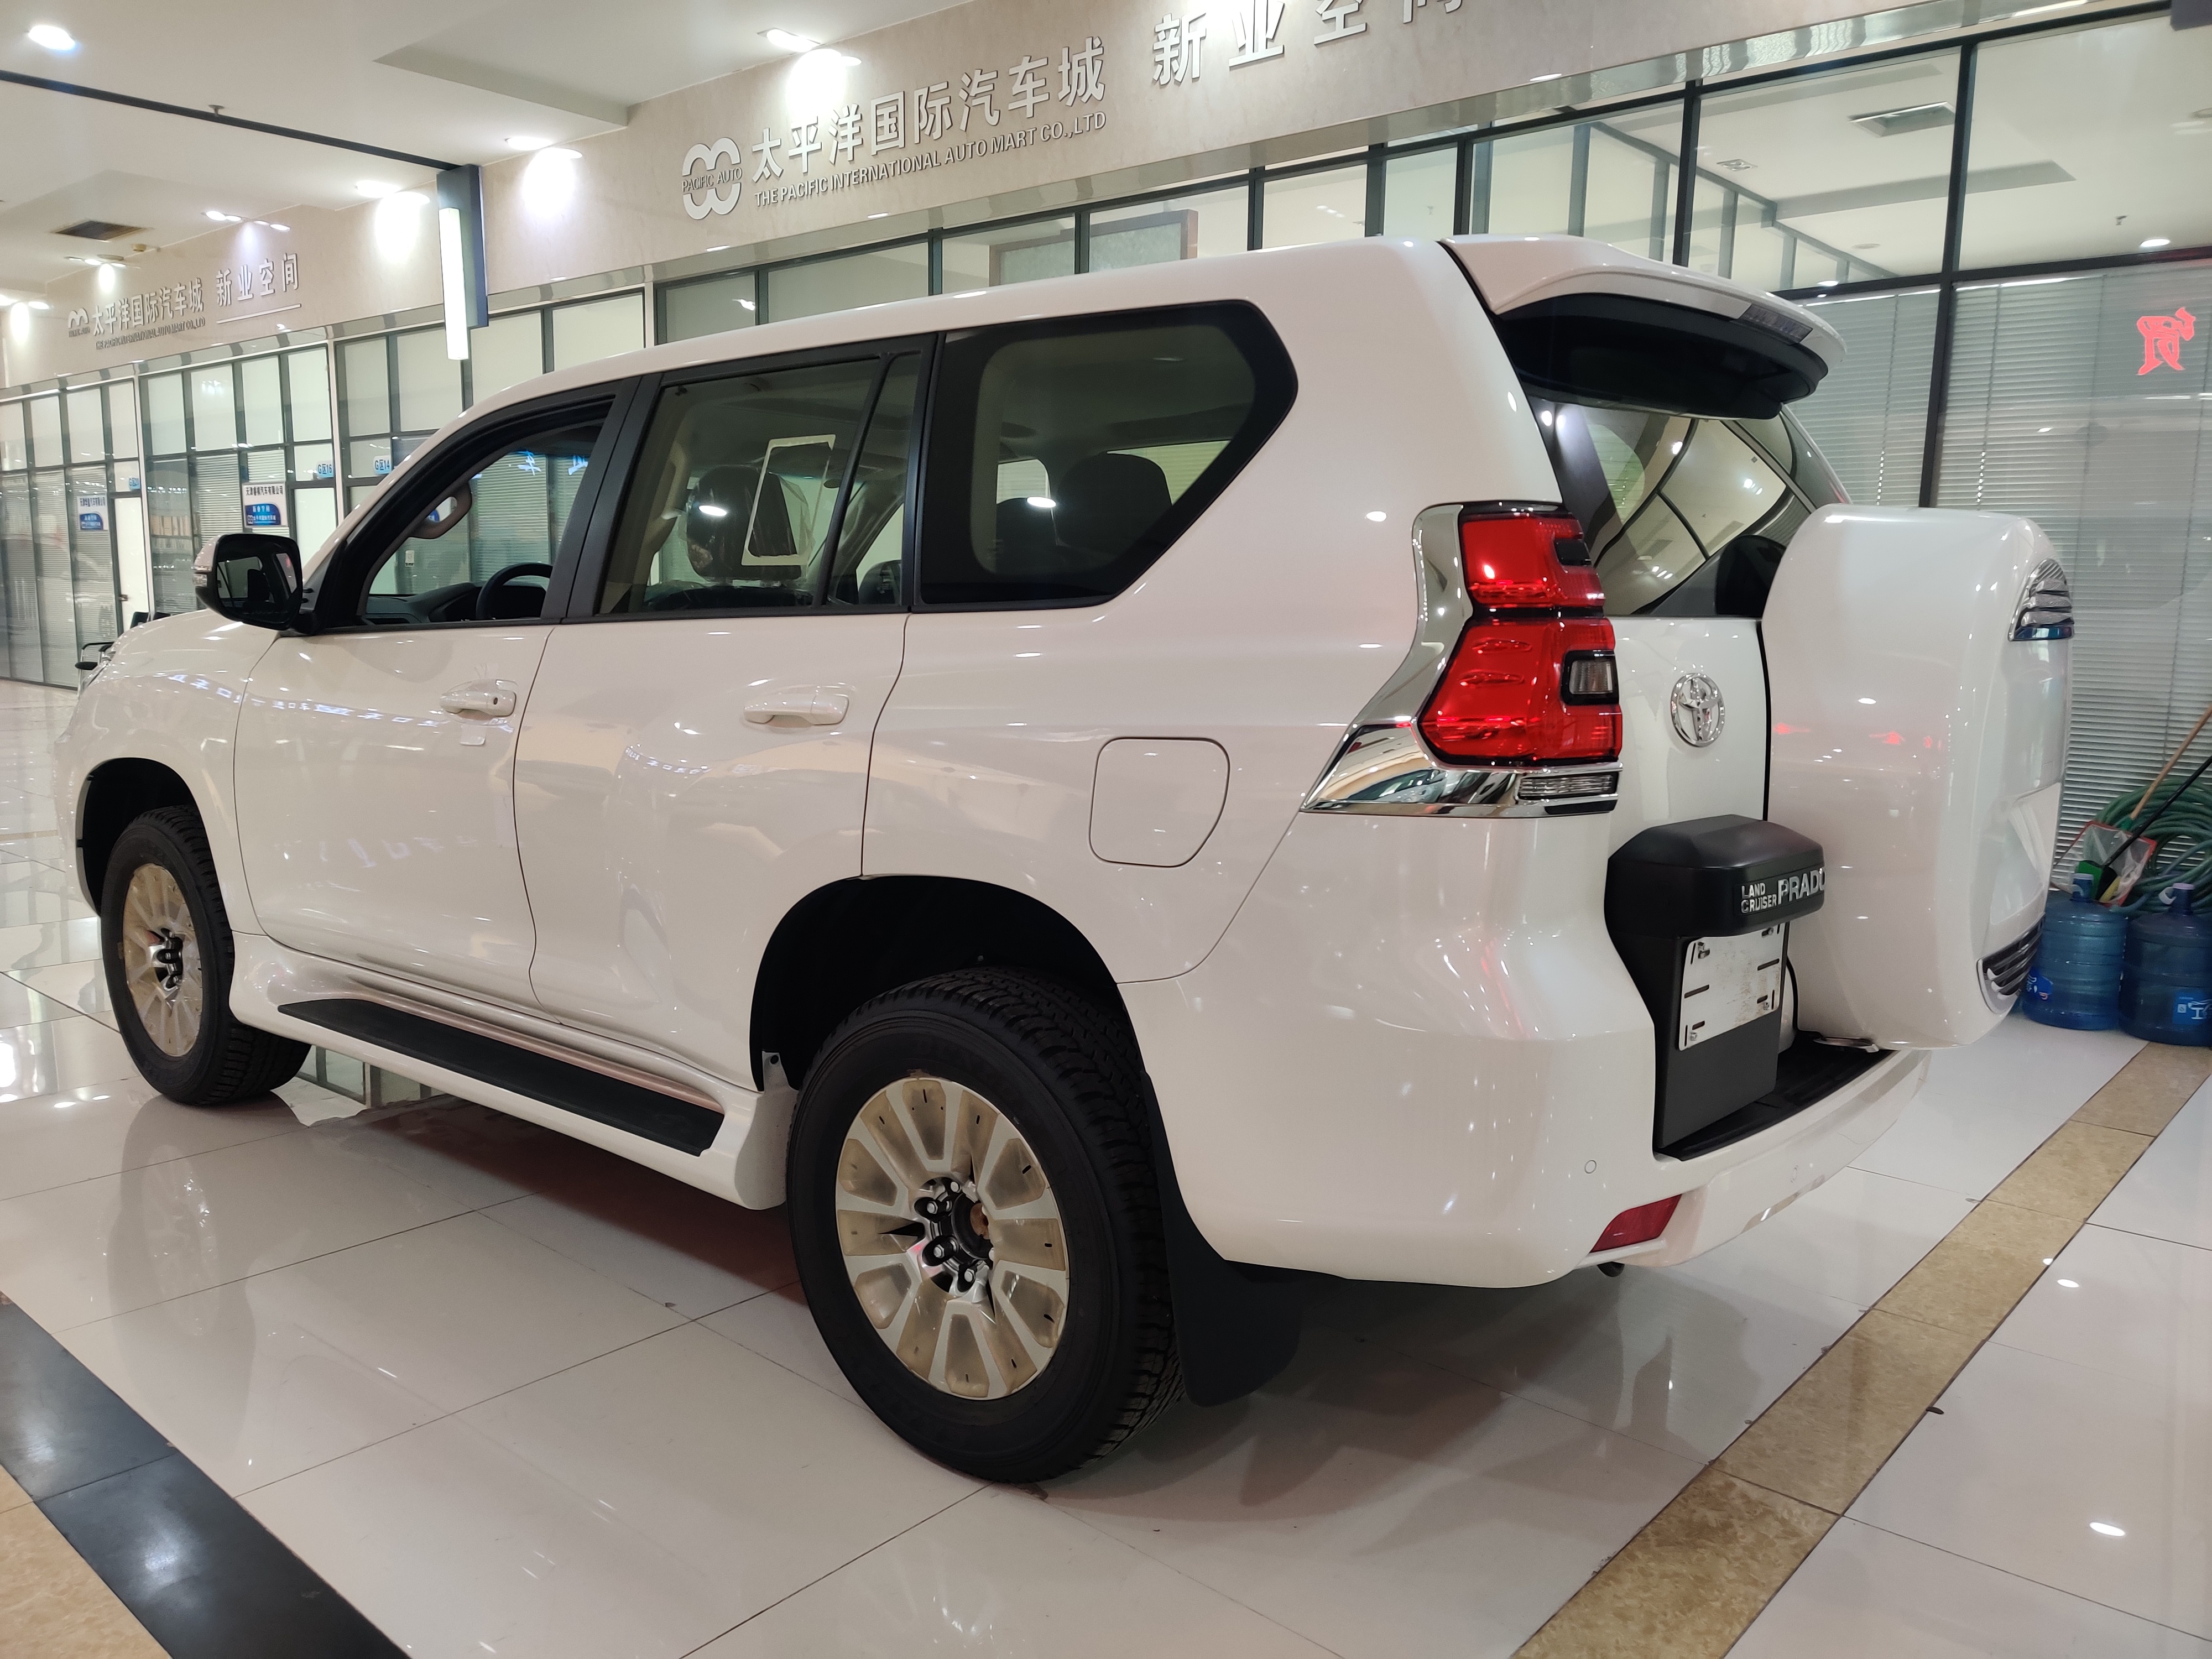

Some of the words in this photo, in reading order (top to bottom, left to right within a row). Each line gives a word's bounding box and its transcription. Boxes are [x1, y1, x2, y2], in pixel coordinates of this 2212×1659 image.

[1152, 0, 1462, 85] 新业空
[751, 36, 1106, 183] 太平洋国际汽车城
[682, 174, 714, 192] PACIFIC
[717, 167, 743, 185] AUTO
[754, 188, 779, 207] THE
[780, 177, 828, 202] PACIFIC
[830, 150, 941, 191] INTERNATIONAL
[944, 139, 988, 165] AUTO
[990, 127, 1037, 154] MART
[91, 277, 204, 337] 太平洋国际汽车城
[216, 252, 299, 307] 新业空间
[1741, 883, 1766, 899] LAND
[1741, 894, 1777, 914] CRUISER
